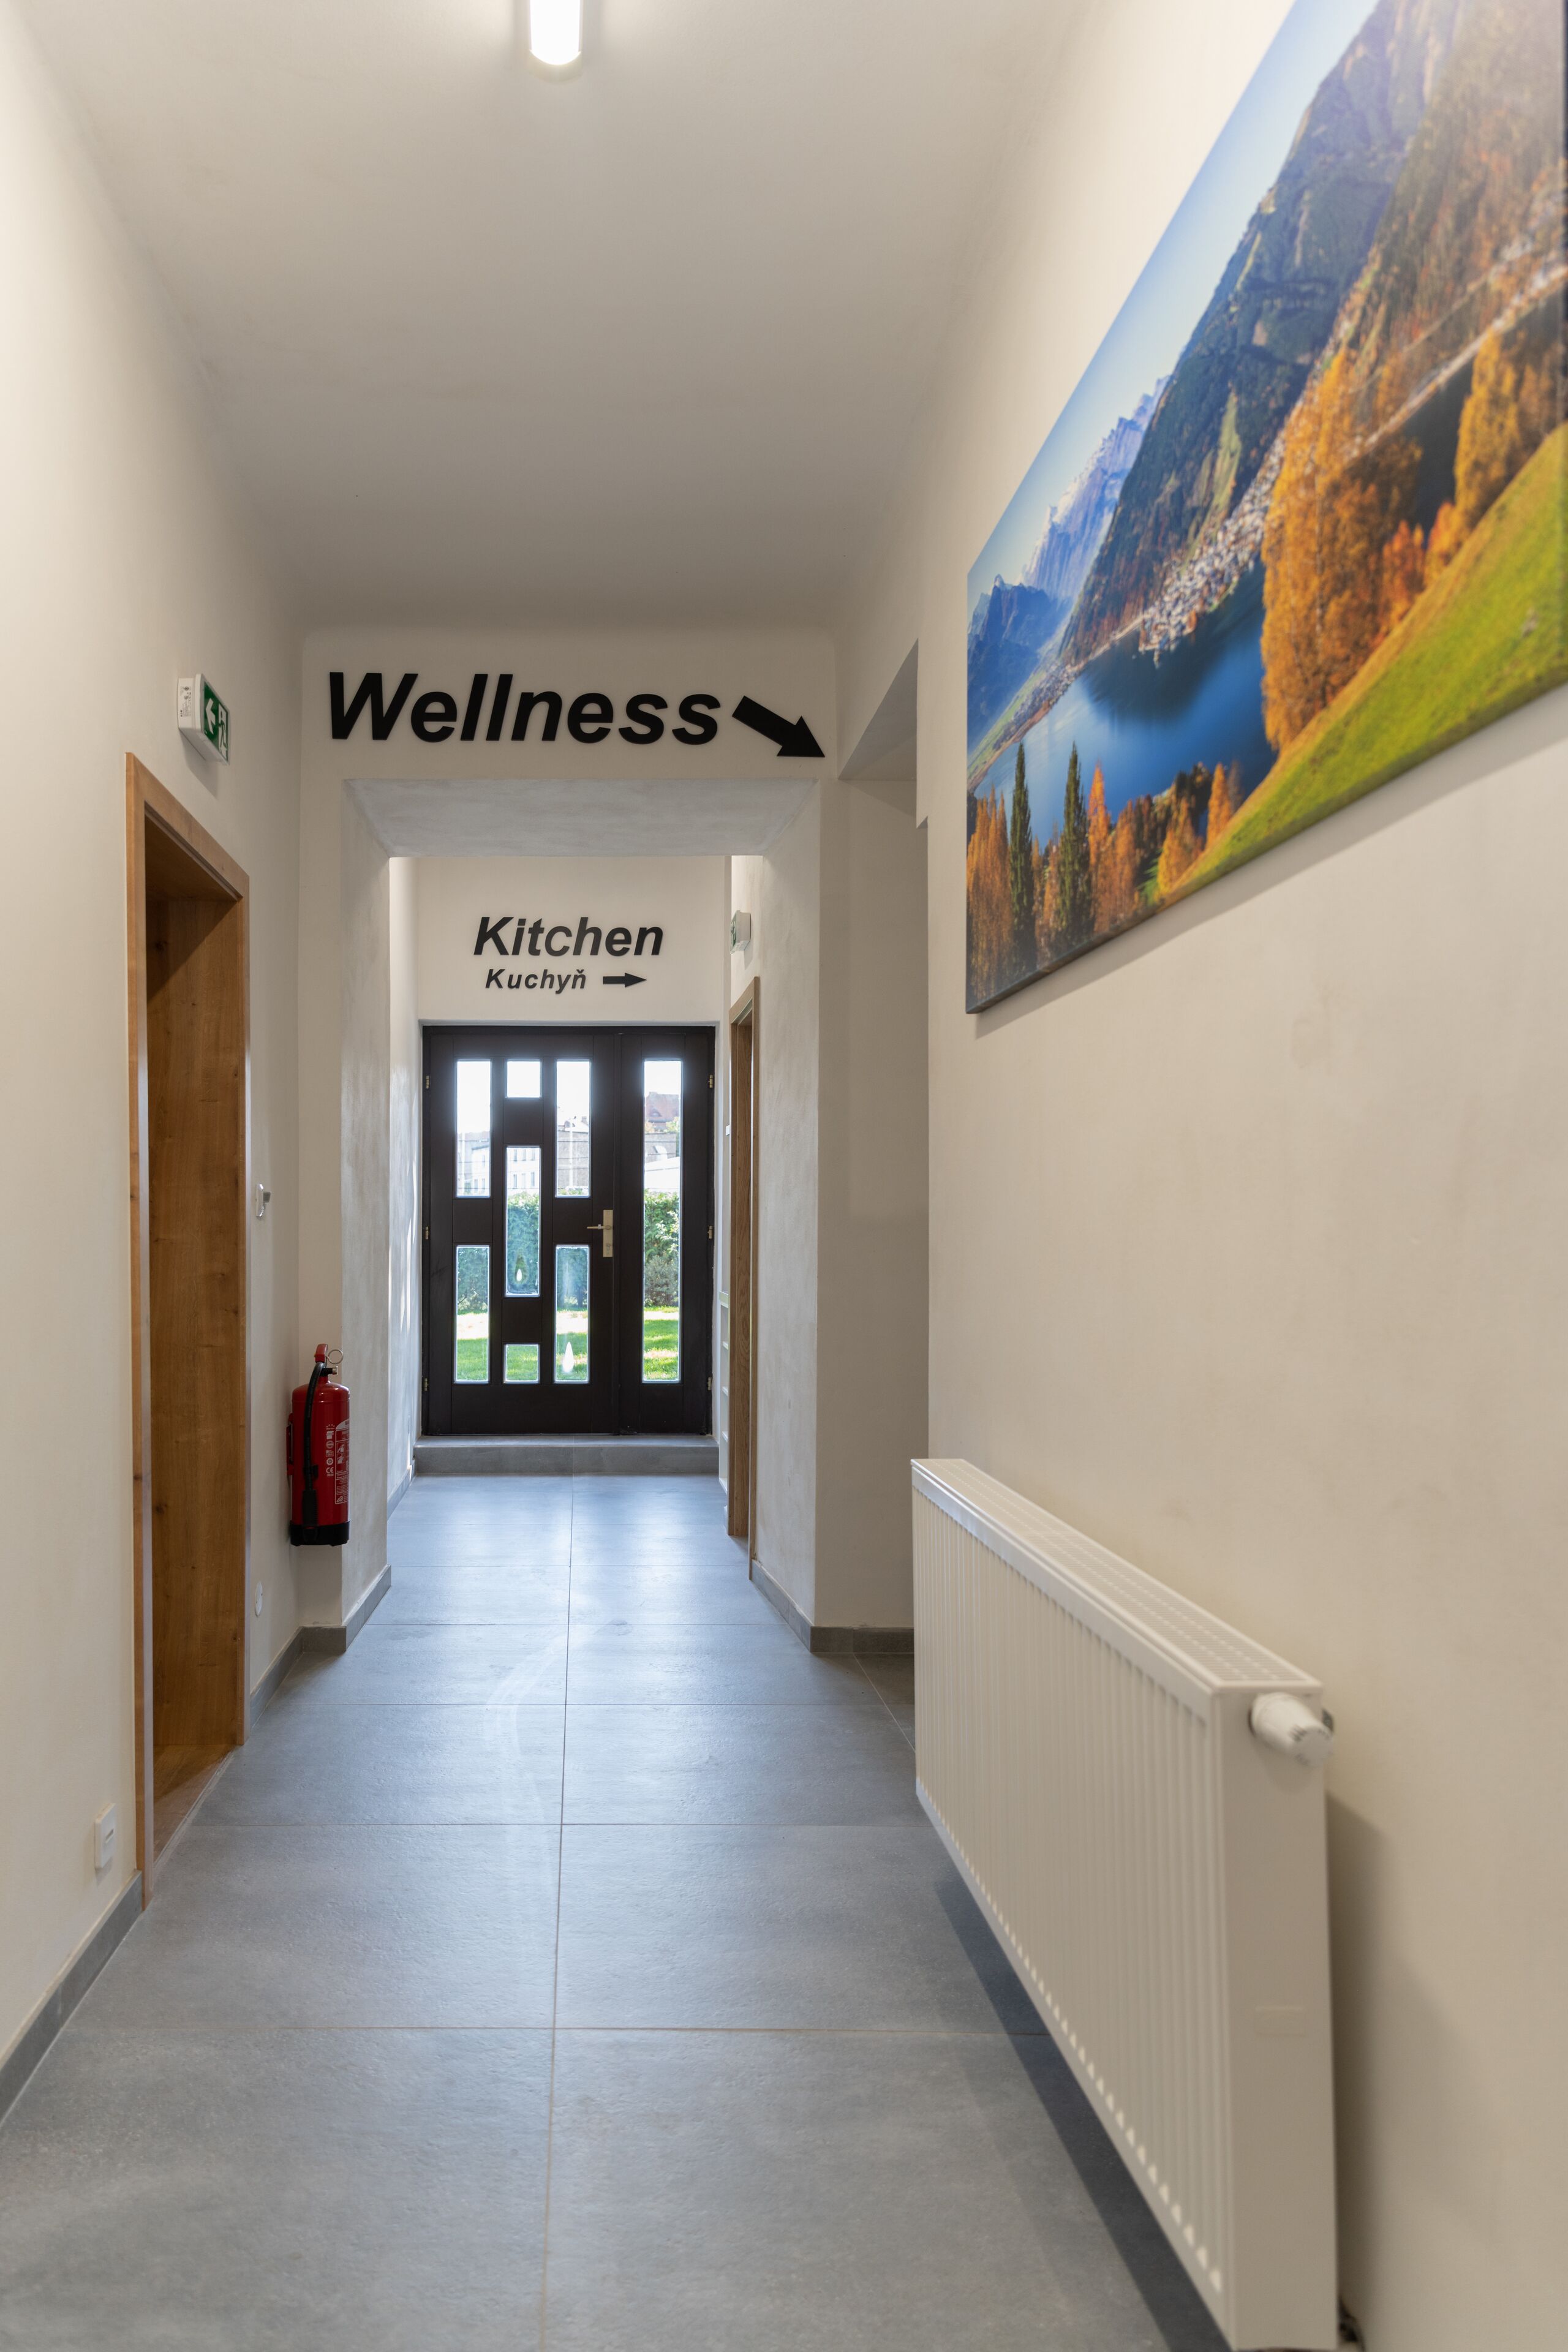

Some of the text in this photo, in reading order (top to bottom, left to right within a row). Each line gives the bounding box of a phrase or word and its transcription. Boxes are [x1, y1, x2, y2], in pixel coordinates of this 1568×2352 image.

[330, 672, 721, 745] Wellness
[473, 916, 663, 957] Kitchen
[485, 968, 586, 994] Kuchyň
